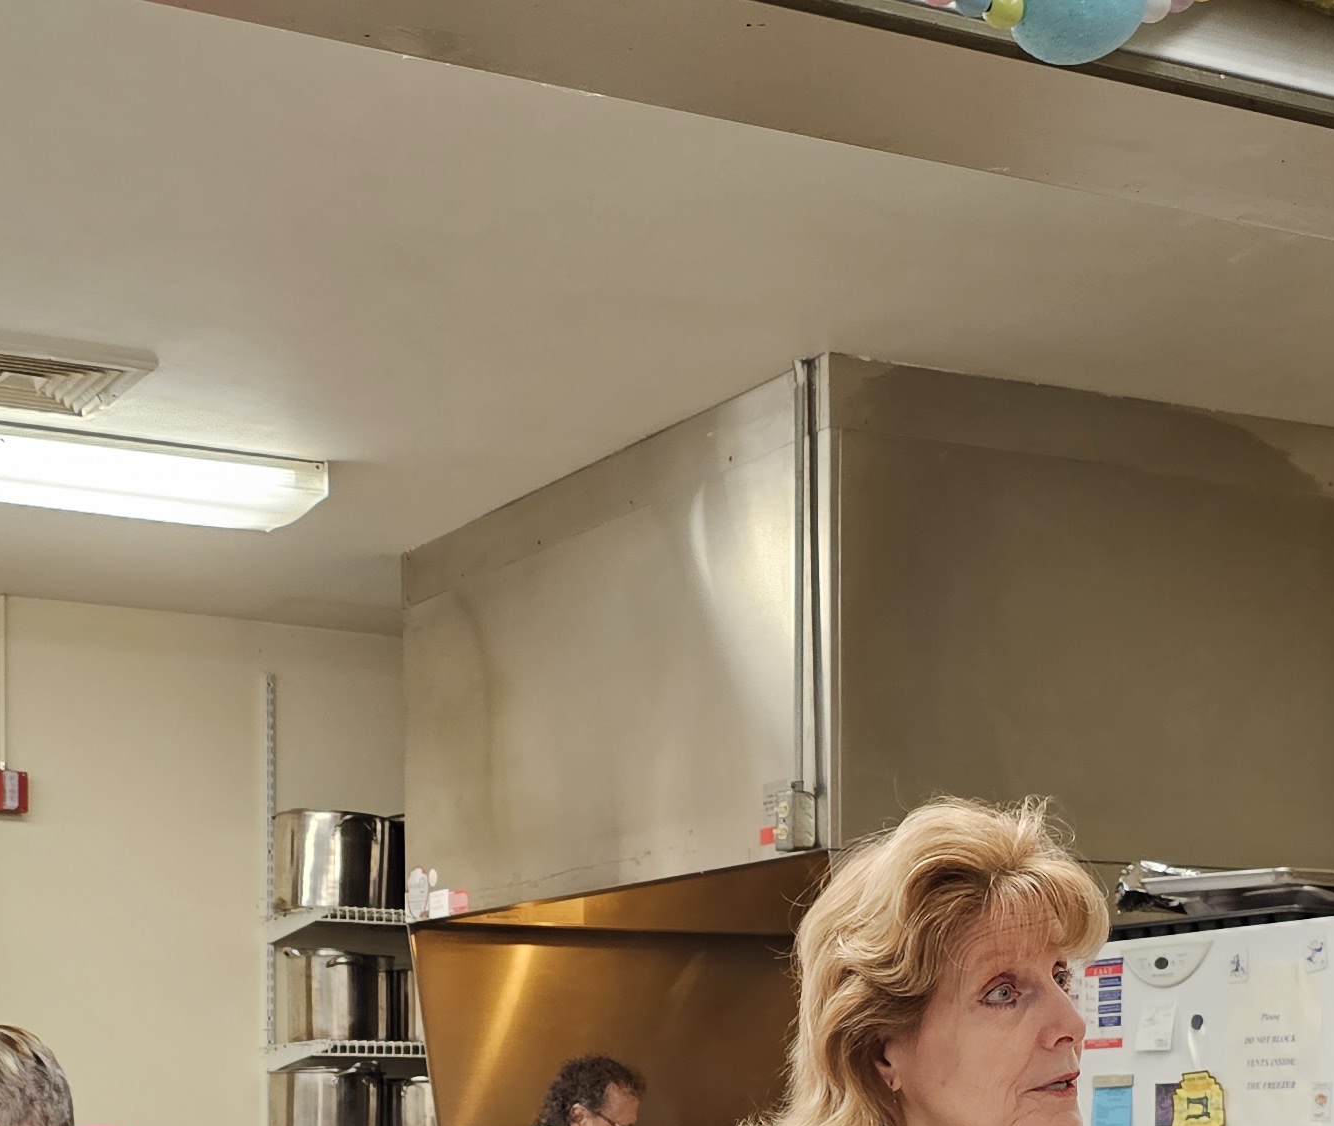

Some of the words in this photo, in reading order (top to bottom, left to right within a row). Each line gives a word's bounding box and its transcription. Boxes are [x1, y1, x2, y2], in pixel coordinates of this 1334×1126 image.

[1271, 1034, 1296, 1043] BLOCK
[1246, 1081, 1261, 1090] THE
[1262, 1080, 1297, 1090] FREEZER
